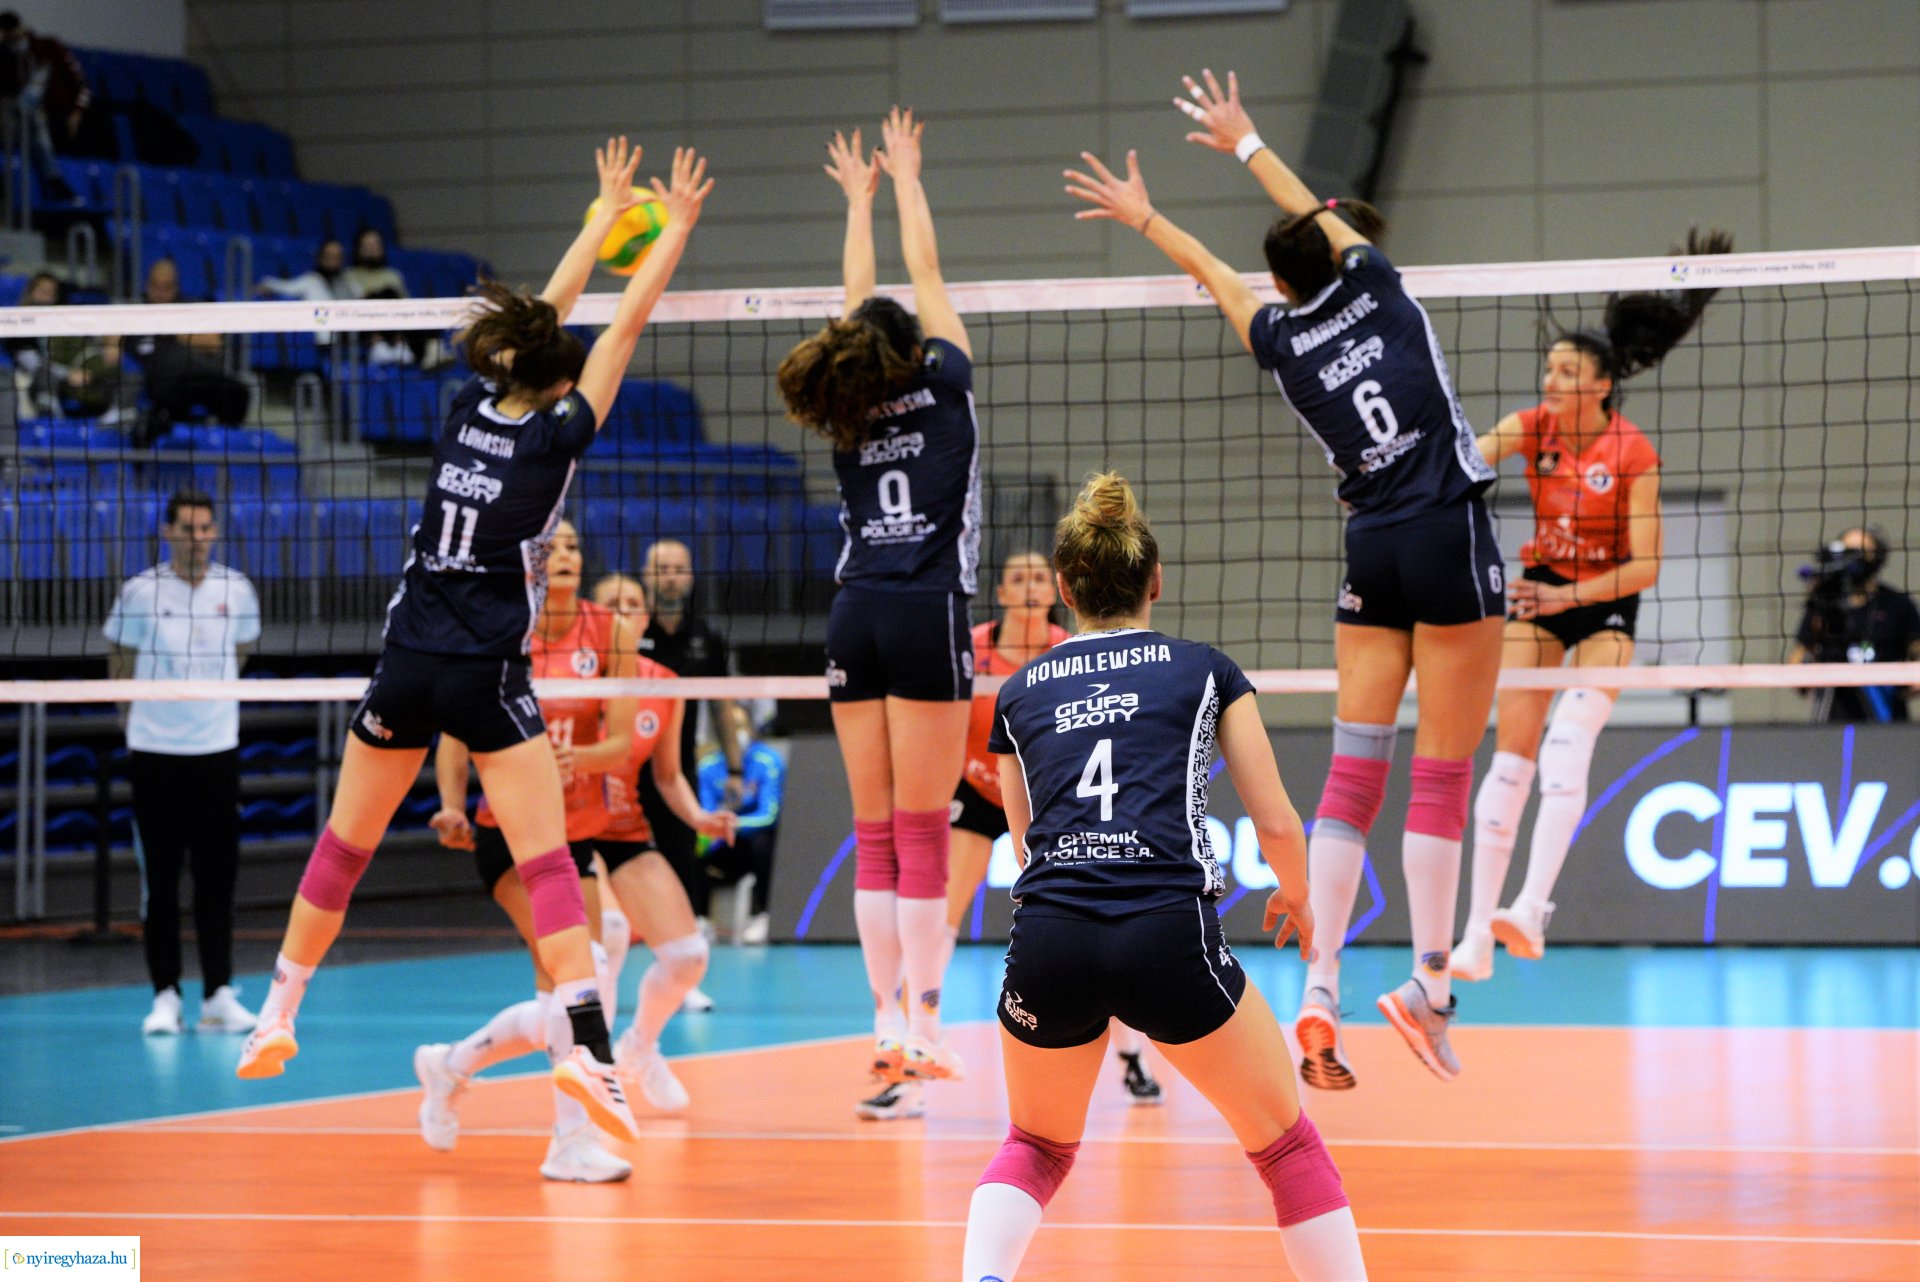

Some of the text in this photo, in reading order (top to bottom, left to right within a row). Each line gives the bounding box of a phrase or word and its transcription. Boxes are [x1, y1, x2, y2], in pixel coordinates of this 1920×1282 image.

[1352, 379, 1399, 444] 6
[878, 469, 912, 522] 9
[438, 500, 479, 561] 11
[1487, 565, 1502, 594] 6
[1026, 644, 1171, 688] KOWALEWSKA
[515, 695, 538, 718] 11
[1076, 738, 1119, 822] 4
[1044, 845, 1121, 862] POLICE
[1058, 829, 1140, 849] CHEMIK
[1624, 781, 1920, 890] CEV.
